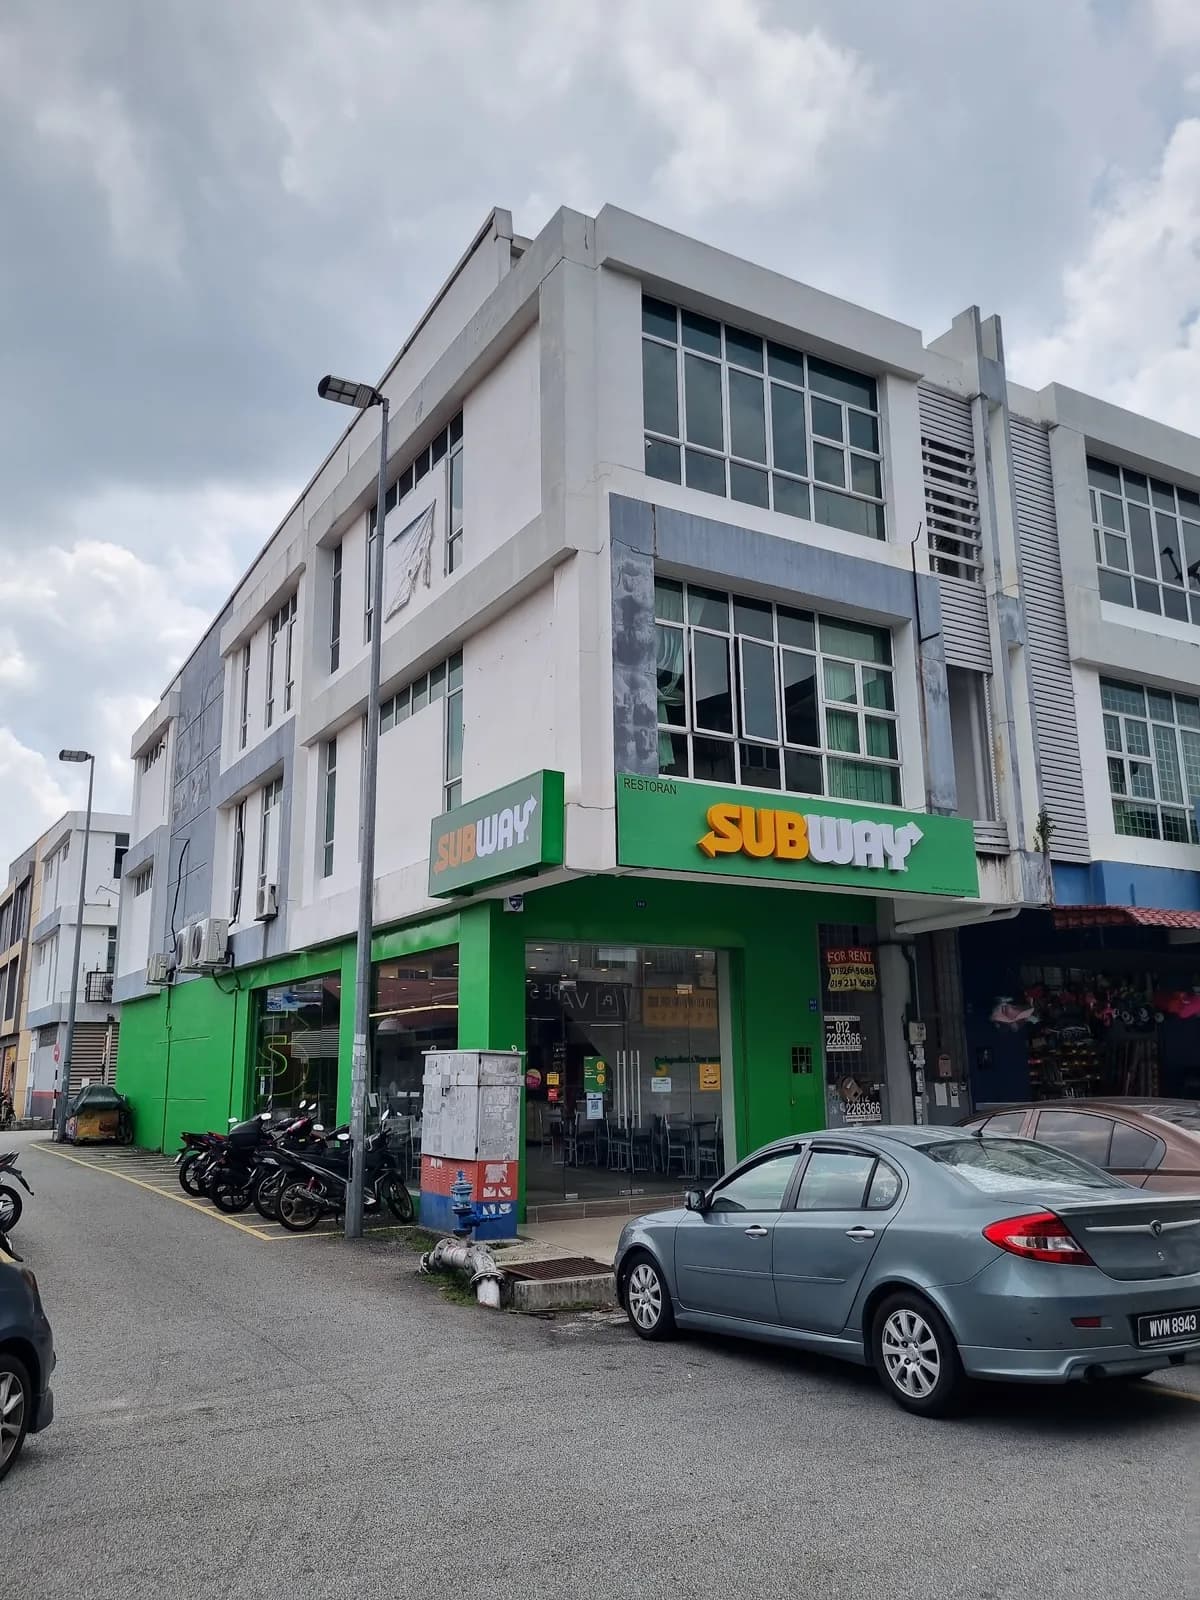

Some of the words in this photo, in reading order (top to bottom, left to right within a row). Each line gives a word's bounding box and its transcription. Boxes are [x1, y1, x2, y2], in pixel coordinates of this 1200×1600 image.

[623, 777, 677, 795] RESTORAN
[433, 794, 537, 875] SUBWAY
[696, 802, 924, 872] SUBWAY
[827, 950, 847, 962] FOR
[848, 950, 872, 962] RENT
[835, 1021, 850, 1033] 012
[826, 1032, 861, 1045] 2283366
[846, 1102, 881, 1115] 2283366
[1150, 1318, 1170, 1337] WVM
[1172, 1314, 1197, 1333] 8943
